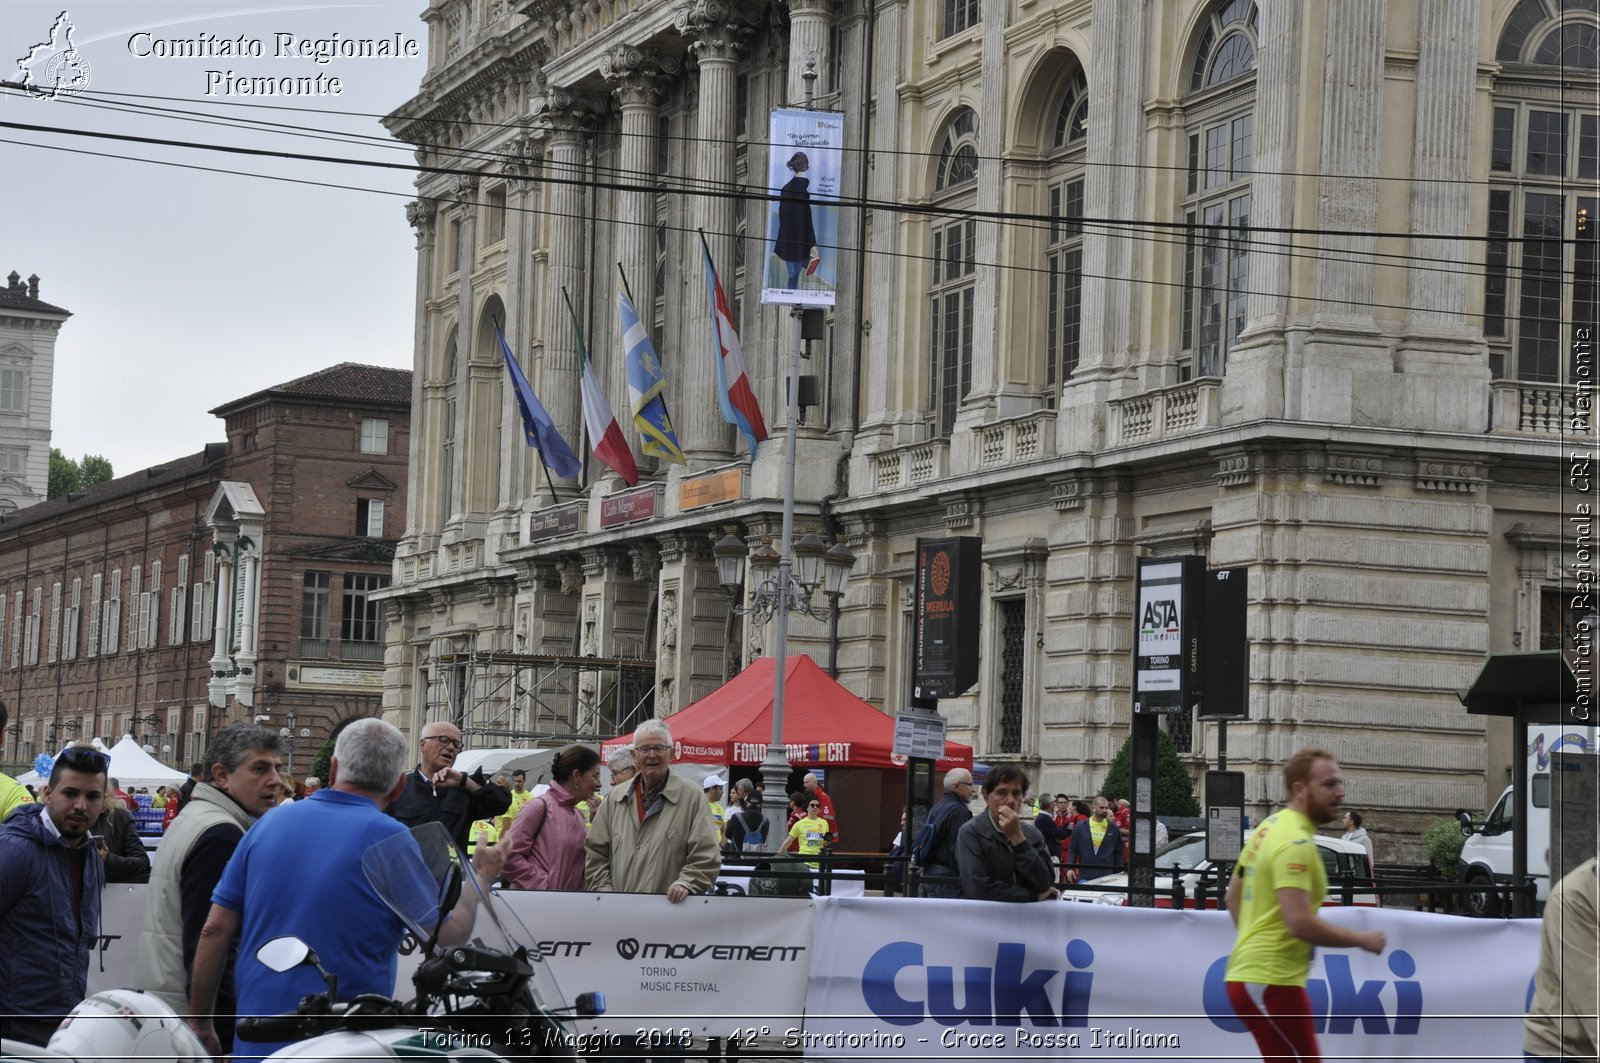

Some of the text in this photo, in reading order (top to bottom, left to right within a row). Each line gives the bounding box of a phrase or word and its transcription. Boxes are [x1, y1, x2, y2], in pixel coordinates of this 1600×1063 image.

[604, 501, 617, 517] Carlo
[618, 499, 635, 518] Magno
[1217, 571, 1231, 580] GTT
[926, 600, 954, 612] MERULA
[1142, 600, 1179, 629] ASTA
[918, 658, 923, 670] LA
[1150, 656, 1169, 665] TORINO
[683, 745, 696, 755] CROCE
[696, 746, 707, 756] ROSSA
[827, 743, 851, 761] CRT
[640, 967, 677, 977] TORINO
[640, 981, 720, 993] MUSIC FESTIVAL
[862, 938, 1095, 1028] Cuki
[1202, 949, 1423, 1035] Cki
